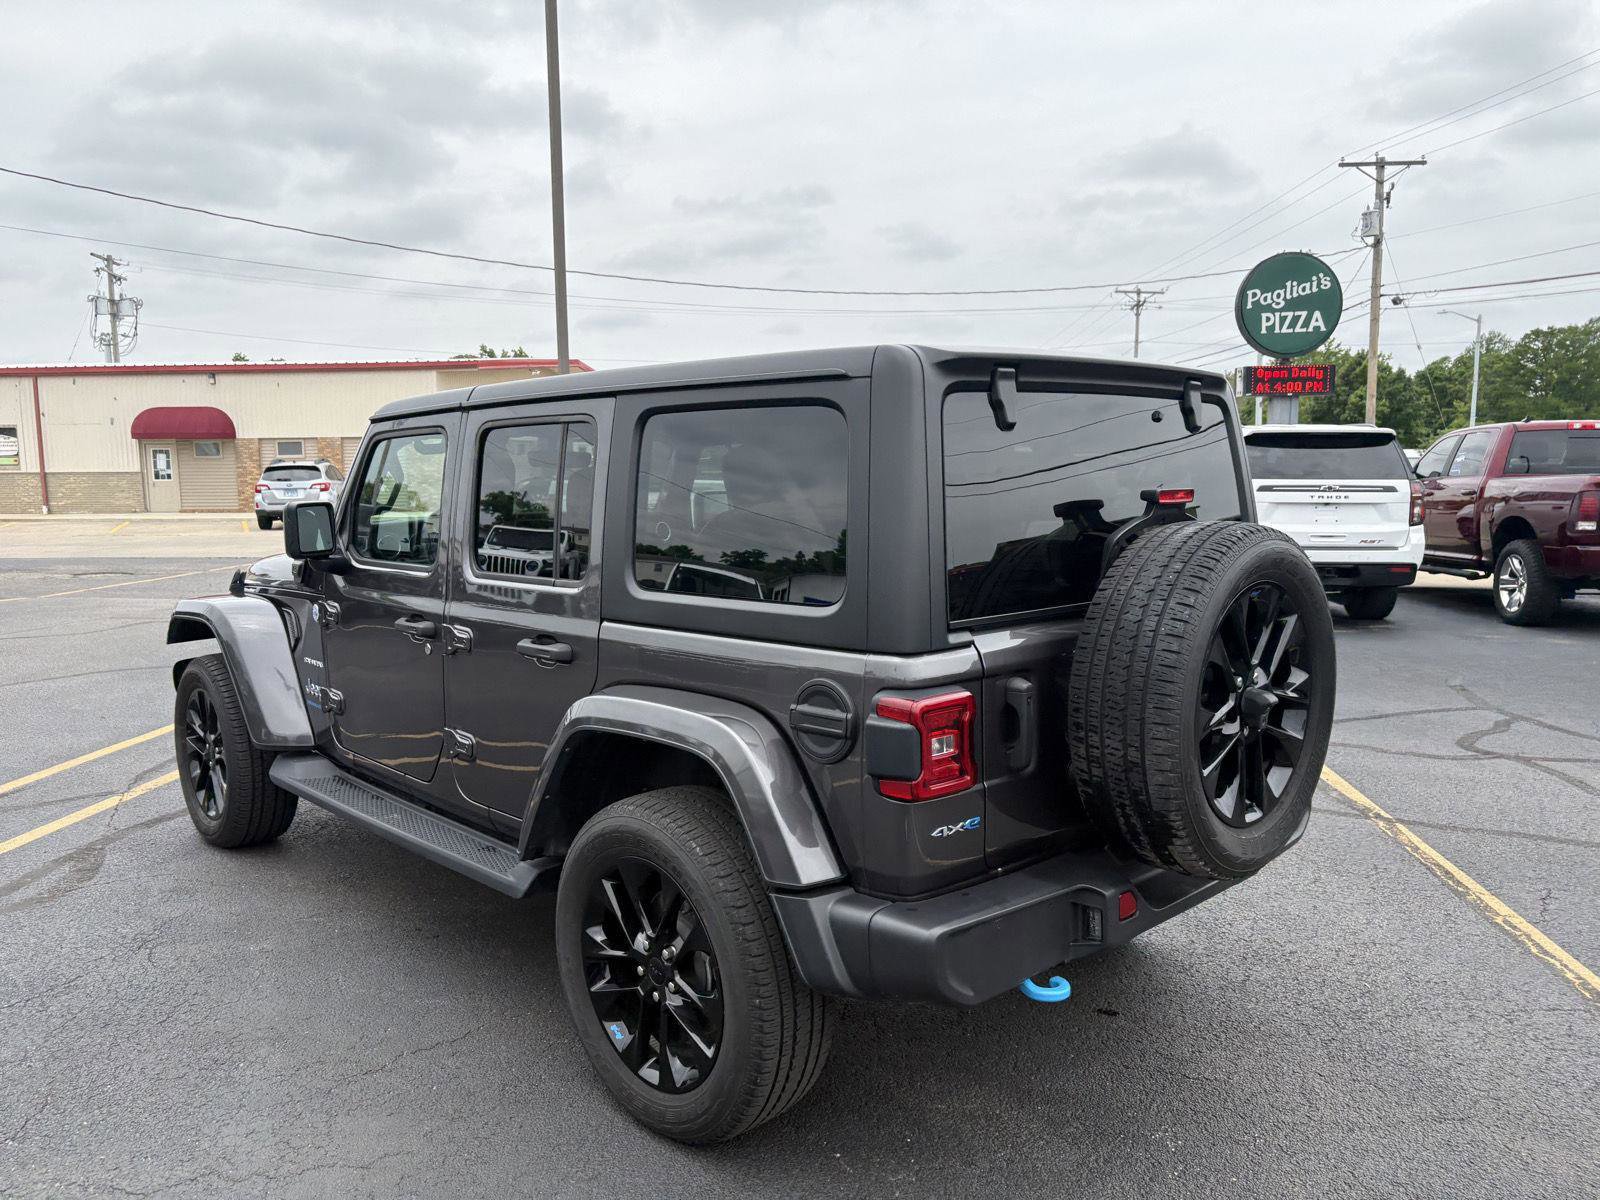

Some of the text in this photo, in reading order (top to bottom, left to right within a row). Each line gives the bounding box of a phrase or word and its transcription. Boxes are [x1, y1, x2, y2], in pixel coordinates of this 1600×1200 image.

[1247, 272, 1331, 309] Pagliai's
[1260, 310, 1326, 334] PIZZA
[1256, 368, 1324, 381] Open Daily
[1256, 381, 1324, 393] At 4:00 PM
